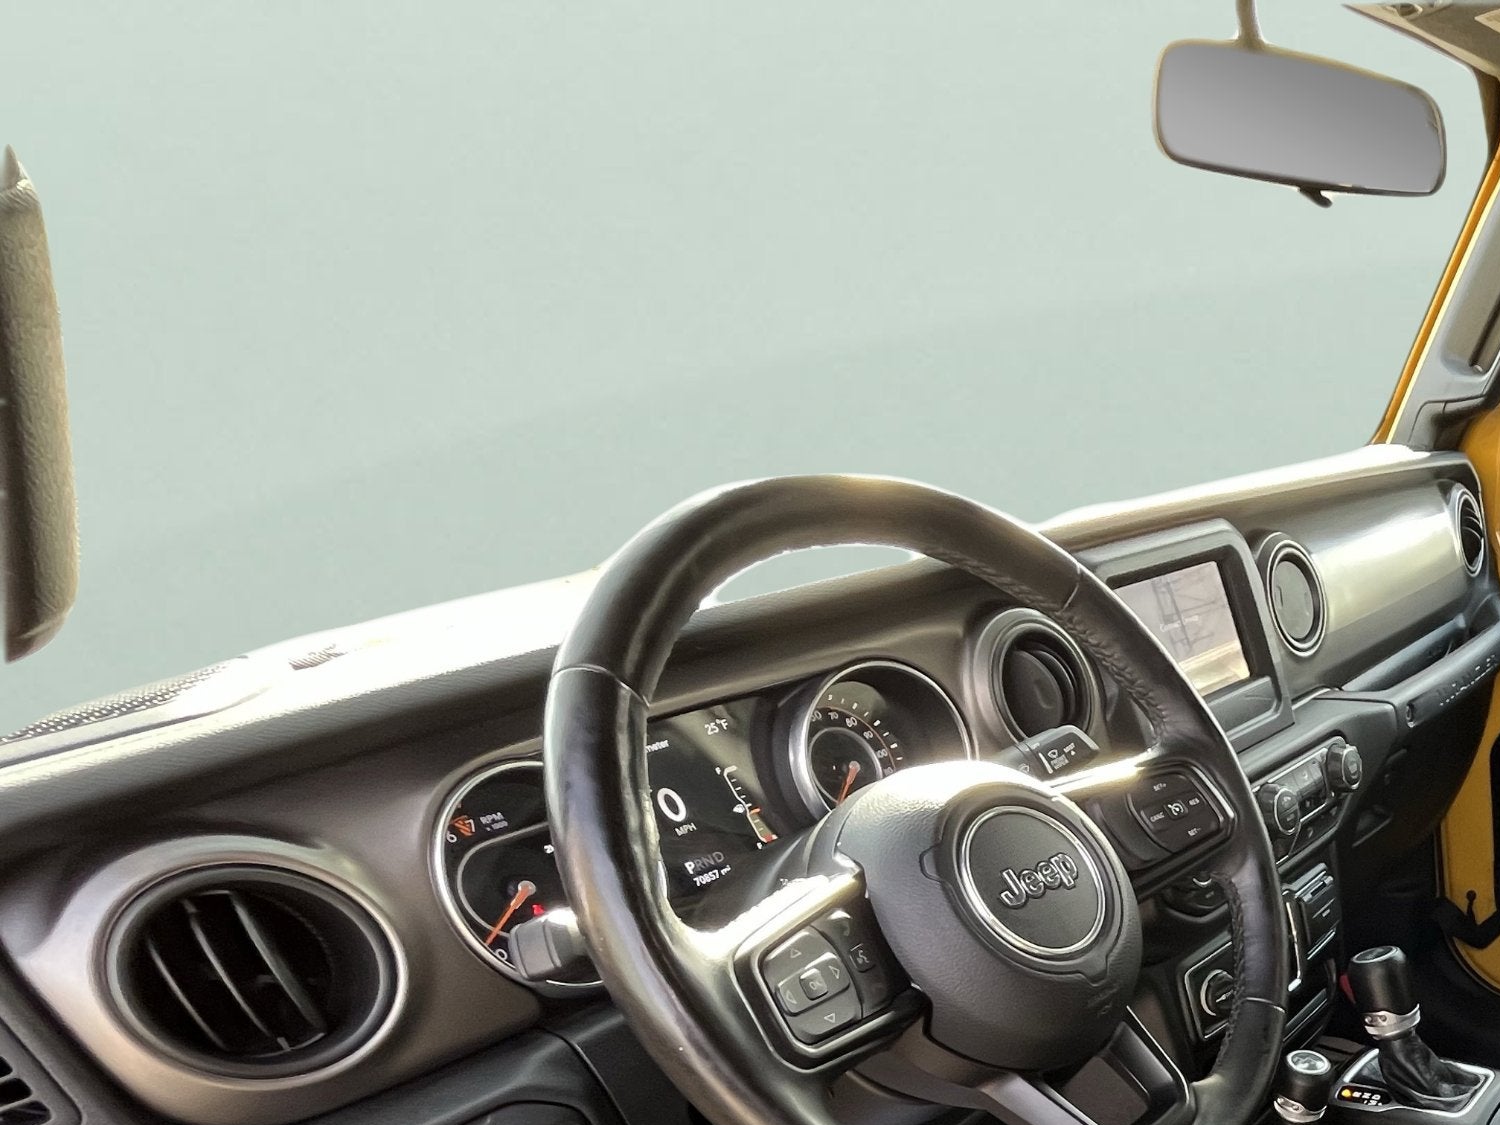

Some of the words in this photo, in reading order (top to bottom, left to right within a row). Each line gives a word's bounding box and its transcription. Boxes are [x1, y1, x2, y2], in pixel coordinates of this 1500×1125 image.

[657, 787, 687, 822] 0
[479, 811, 505, 825] RPM
[674, 822, 697, 837] MPH
[446, 834, 457, 843] 6
[693, 869, 721, 887] 70857
[998, 852, 1079, 909] Jeep
